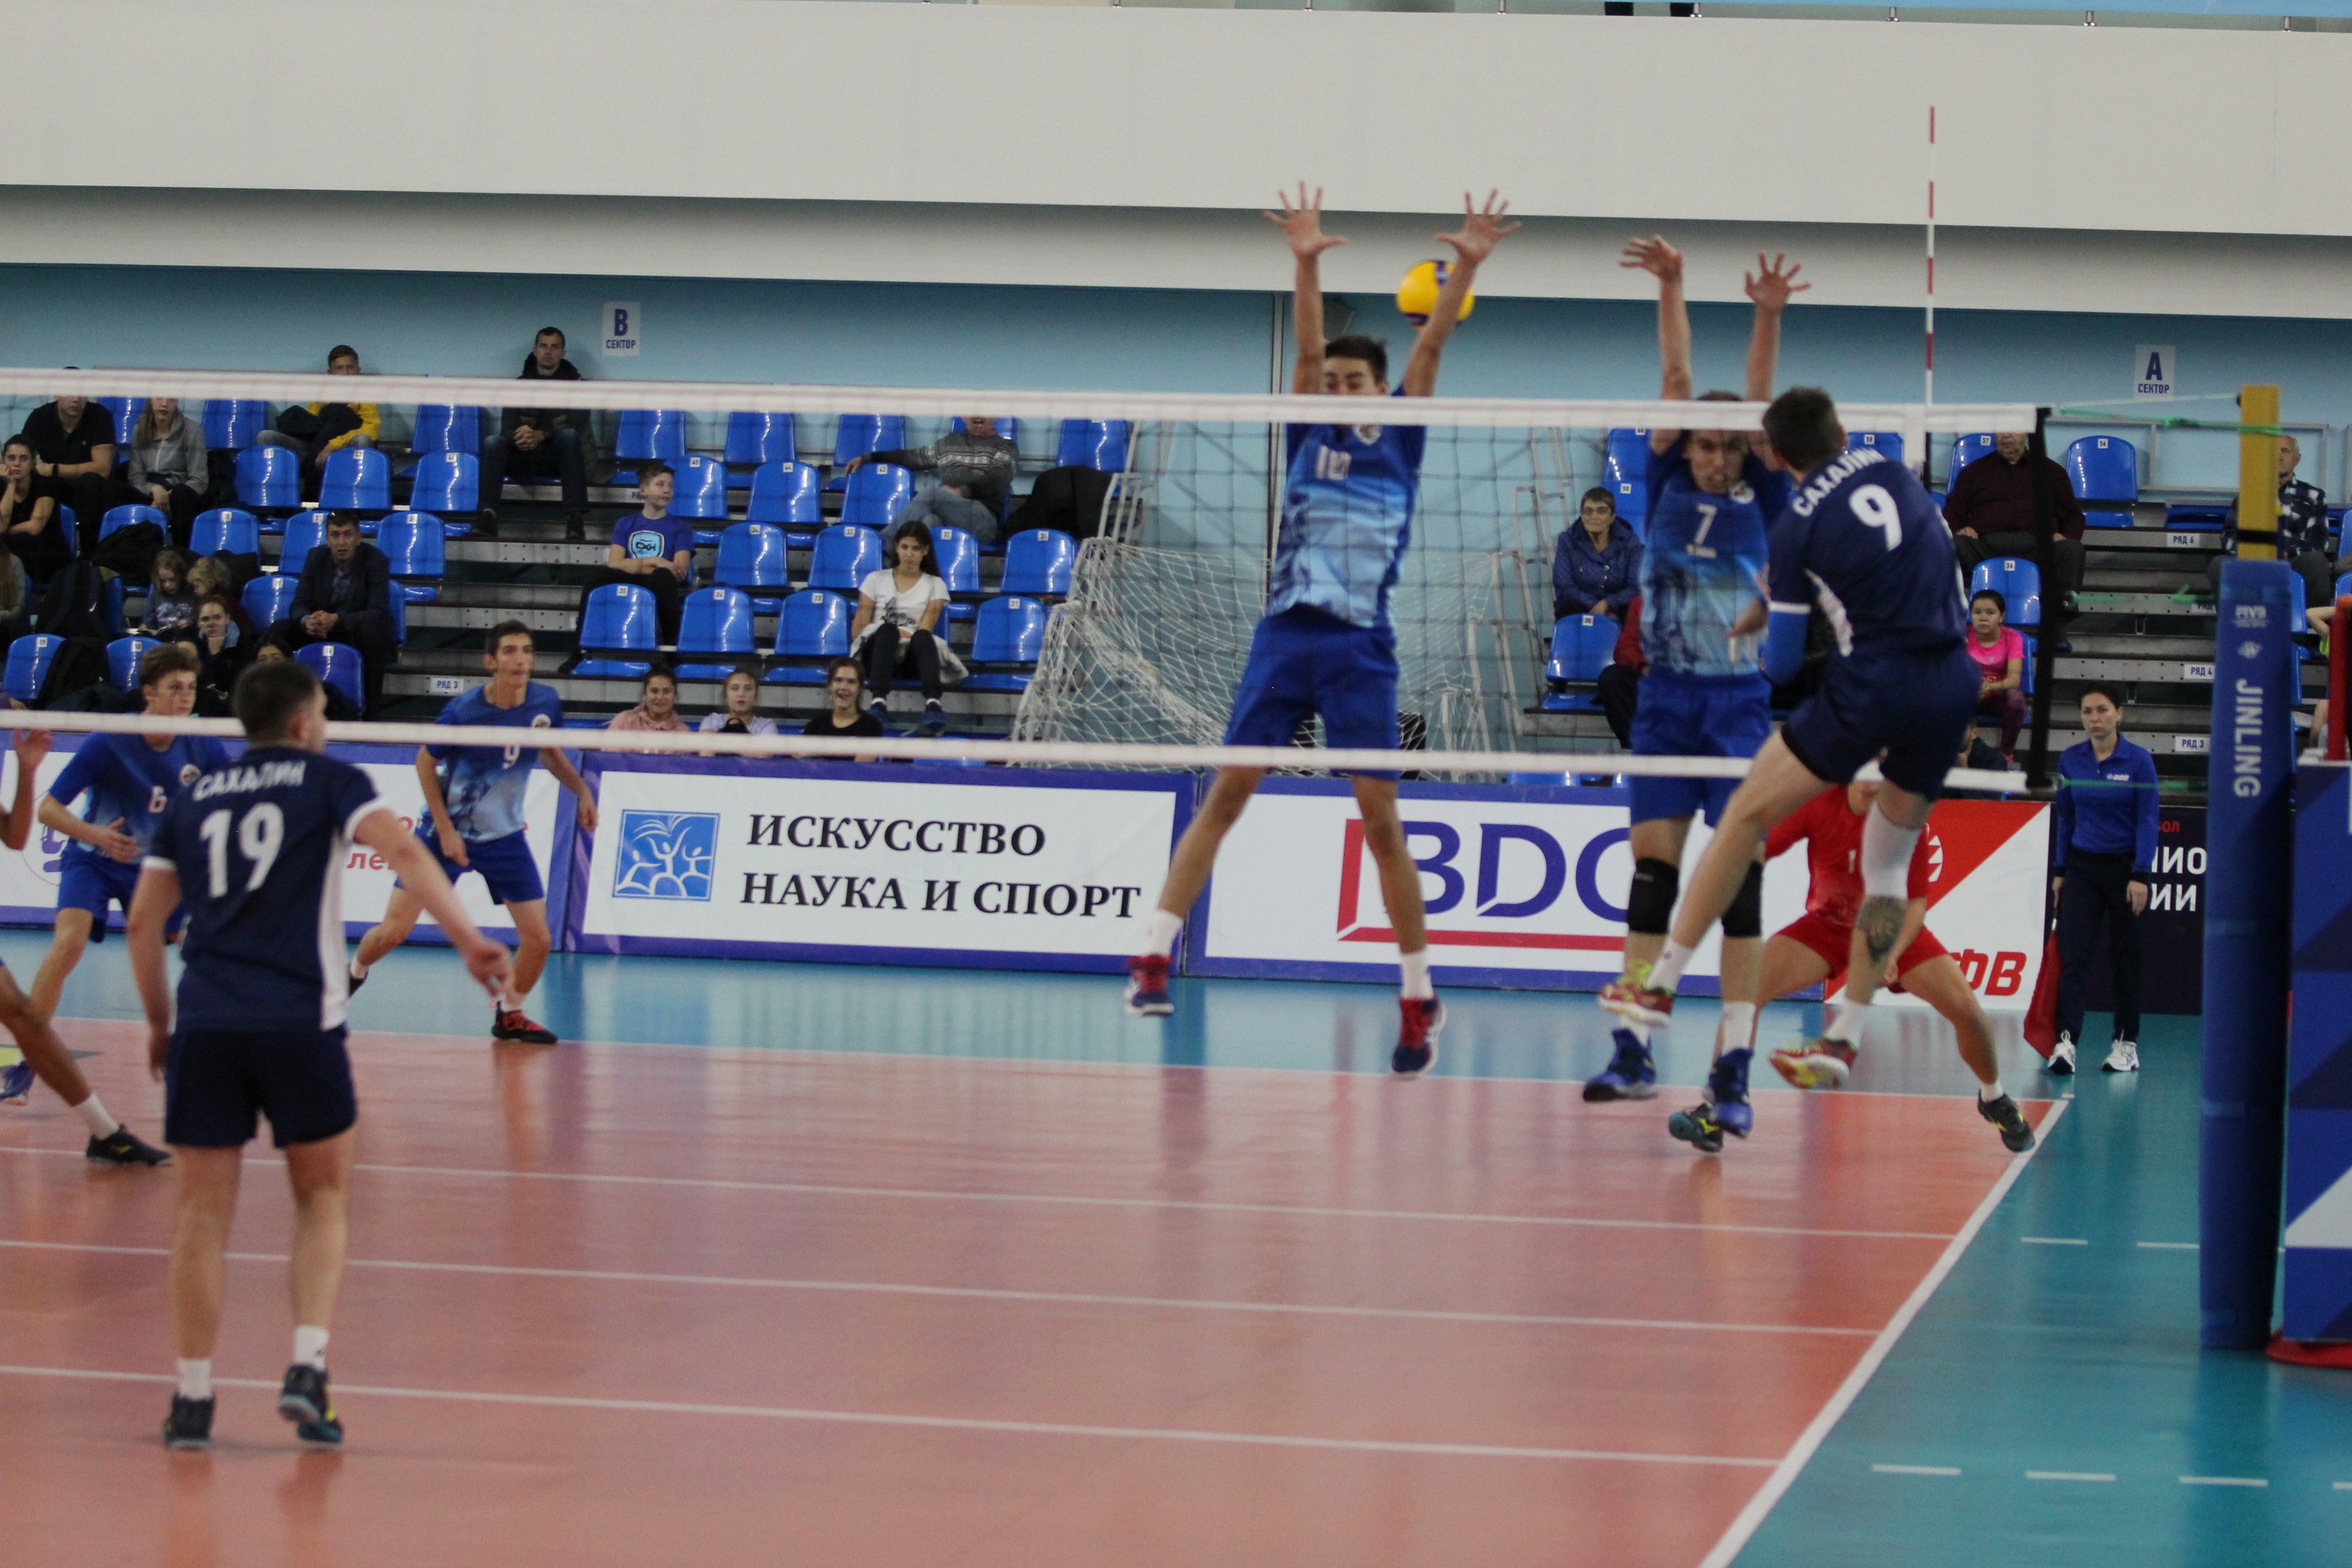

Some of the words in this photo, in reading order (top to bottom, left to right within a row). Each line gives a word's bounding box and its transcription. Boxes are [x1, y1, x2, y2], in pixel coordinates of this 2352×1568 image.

[606, 339, 636, 349] СЕКТОР
[2138, 383, 2170, 394] СЕКТОР
[1694, 503, 1718, 545] 7
[1848, 483, 1903, 552] 9
[2173, 536, 2187, 545] РЯД
[2191, 666, 2205, 677] РЯД
[2182, 739, 2197, 749] РЯД
[2233, 678, 2263, 797] JINLING
[148, 785, 168, 814] 6
[199, 801, 285, 899] 19
[747, 814, 1045, 855] ИСКУССТВО
[740, 873, 907, 910] НАУКА
[922, 879, 961, 911] И
[973, 881, 1142, 918] СПОРТ
